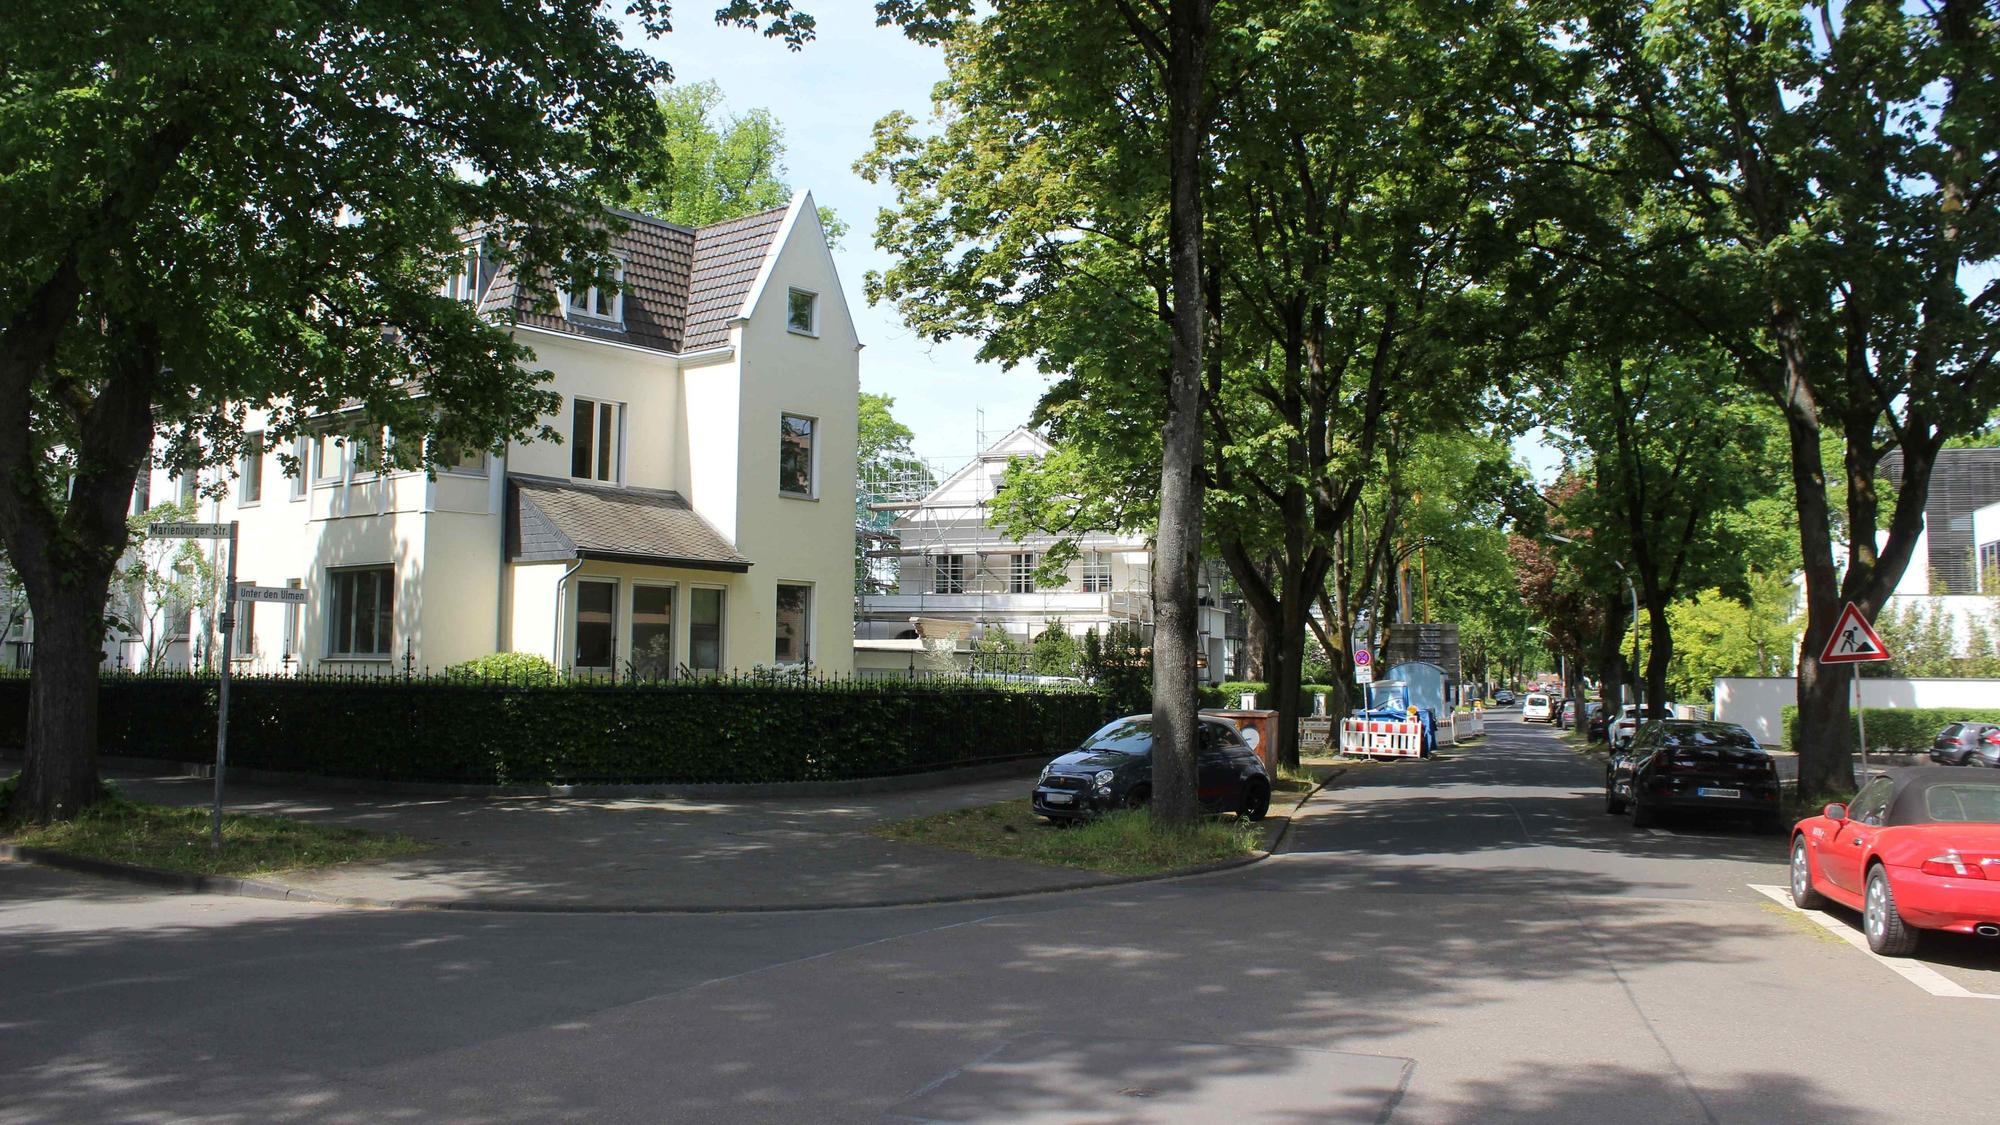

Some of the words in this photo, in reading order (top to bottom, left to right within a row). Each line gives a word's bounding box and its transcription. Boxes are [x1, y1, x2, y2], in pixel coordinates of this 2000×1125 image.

[150, 523, 209, 538] Marienburger
[213, 523, 229, 536] Str.
[240, 587, 261, 598] Unter
[263, 589, 279, 599] den
[280, 589, 305, 601] Ulmen
